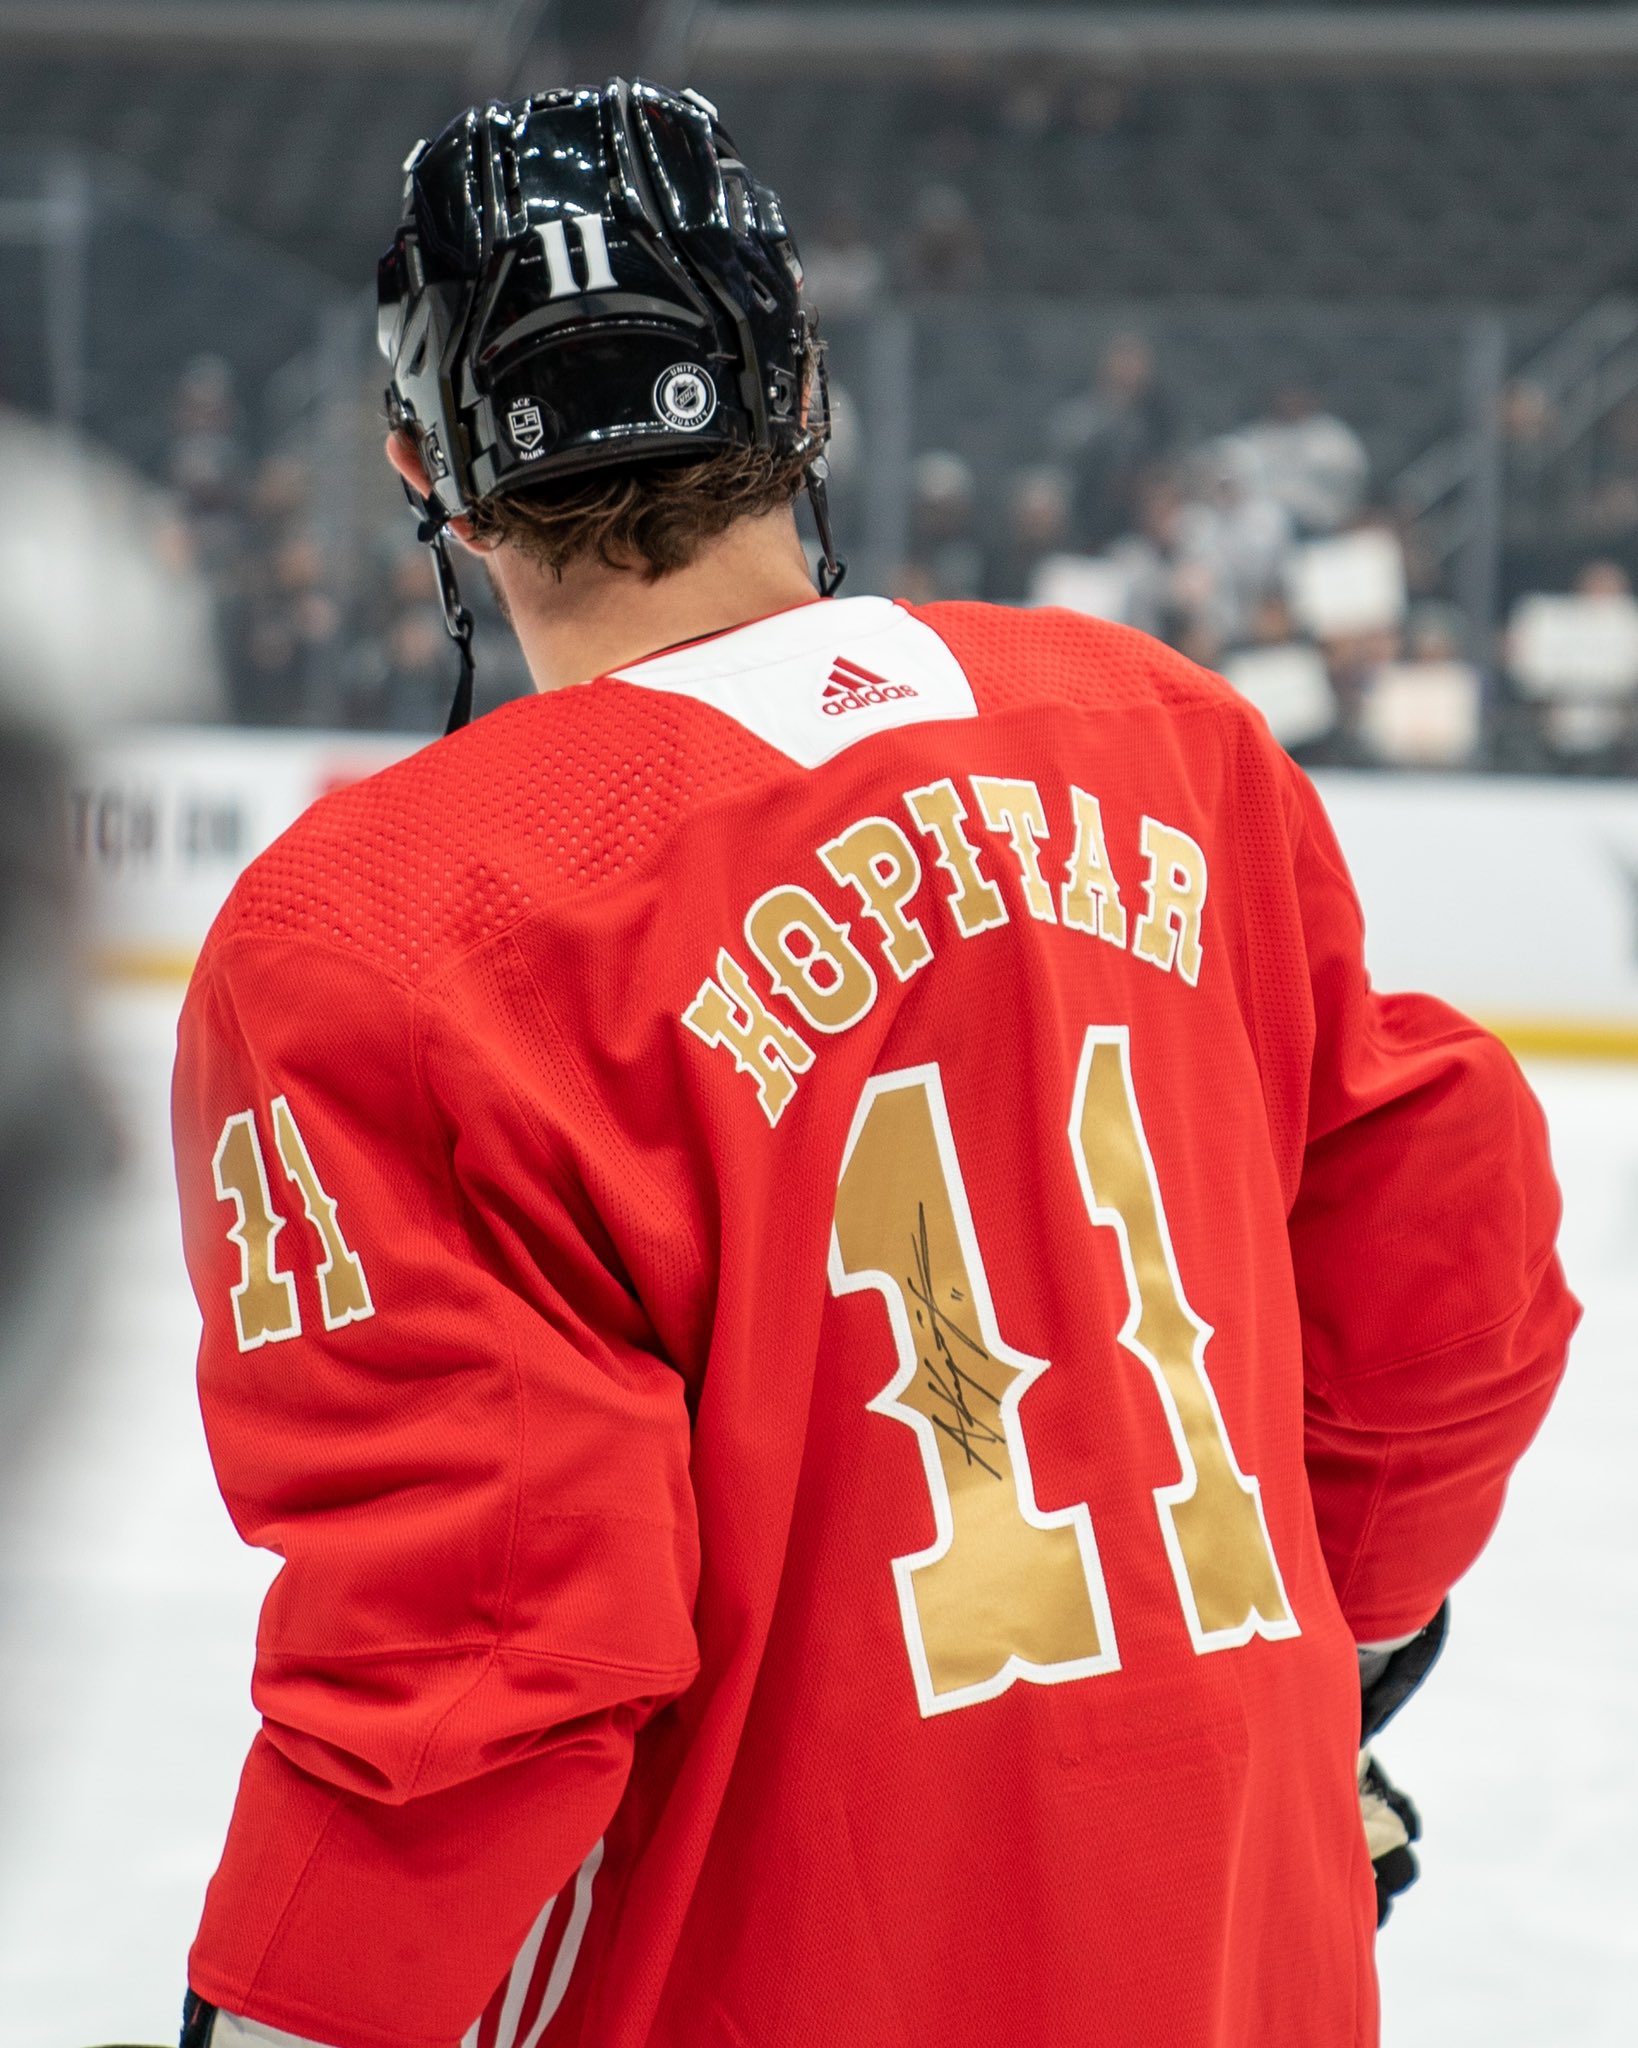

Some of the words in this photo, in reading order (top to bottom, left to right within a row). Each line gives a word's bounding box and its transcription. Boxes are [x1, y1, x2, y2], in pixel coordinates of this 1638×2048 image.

[533, 213, 619, 298] 11
[669, 364, 699, 377] UNITY
[512, 397, 531, 410] ACE
[678, 386, 696, 405] NHL
[512, 411, 538, 429] LA
[665, 409, 709, 427] EQUALITY
[519, 445, 546, 461] MARK
[822, 684, 919, 716] adidas
[681, 775, 1208, 1129] KOPITAR
[211, 1094, 375, 1353] 11
[828, 1024, 1301, 1719] 11
